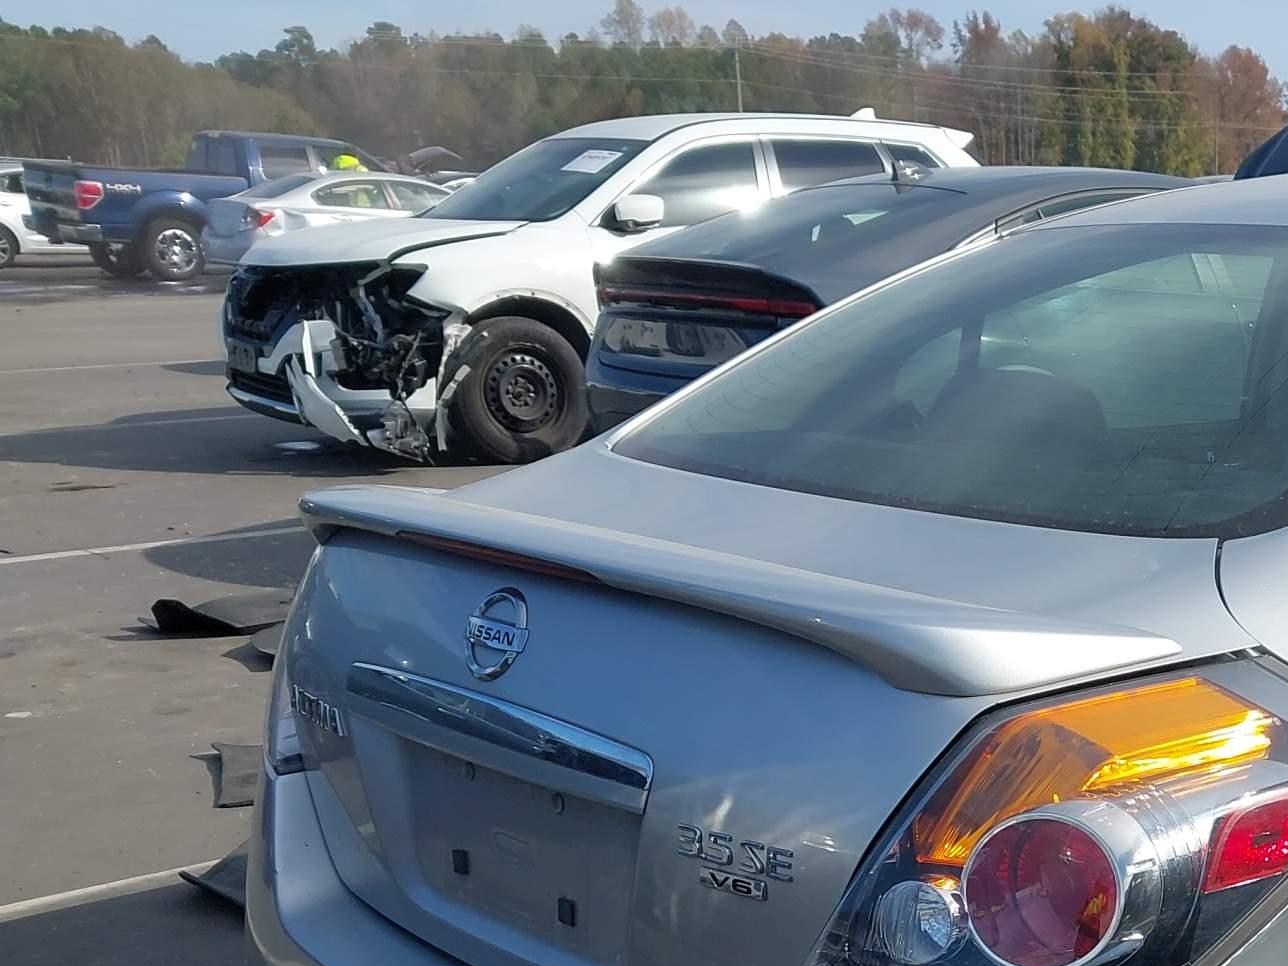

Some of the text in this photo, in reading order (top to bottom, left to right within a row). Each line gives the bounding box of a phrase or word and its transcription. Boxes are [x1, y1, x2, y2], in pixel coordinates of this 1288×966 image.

[468, 621, 516, 646] NISSAN
[739, 839, 795, 883] SE
[709, 871, 752, 895] V6
